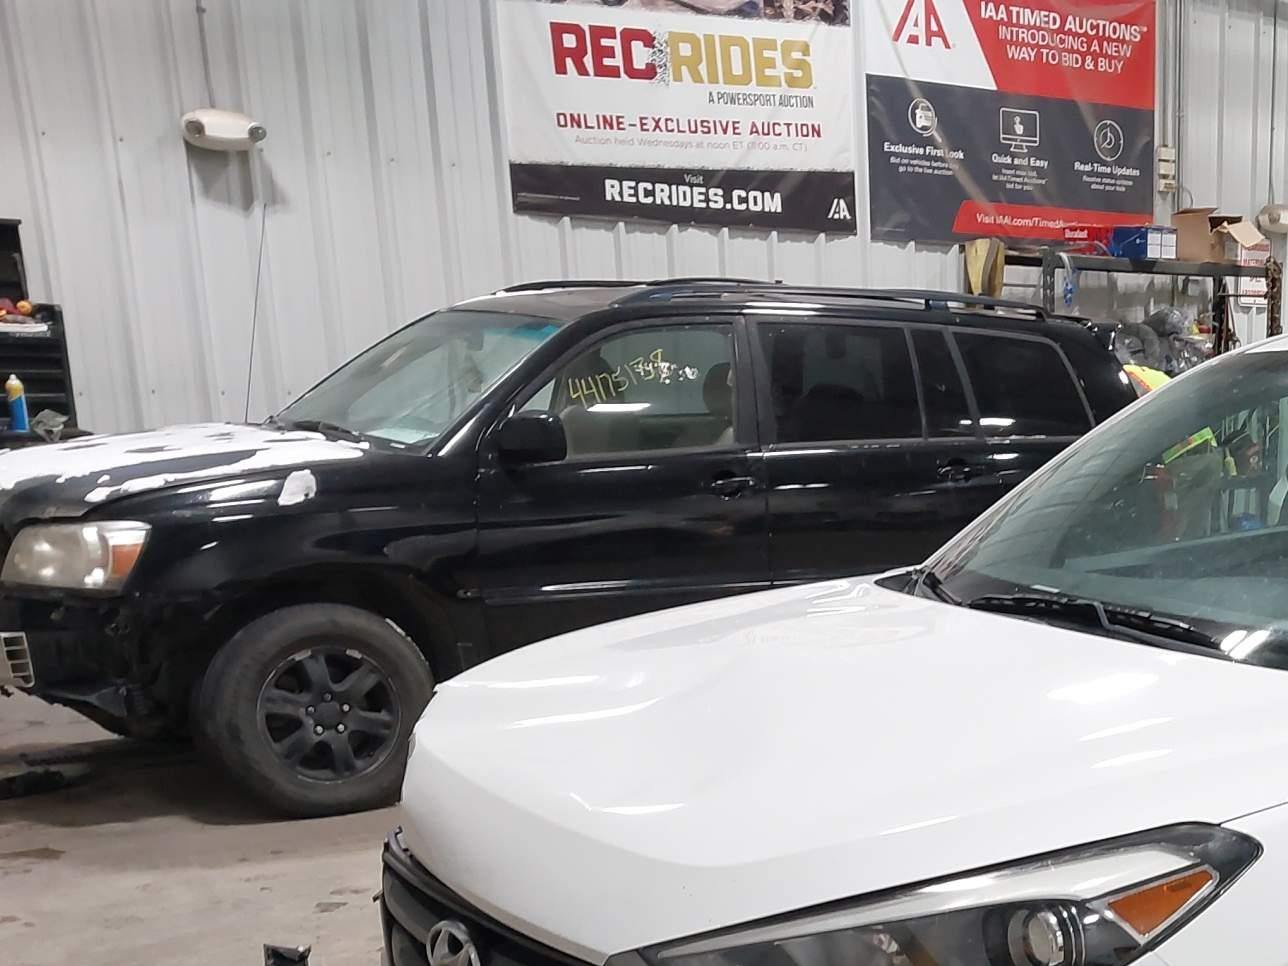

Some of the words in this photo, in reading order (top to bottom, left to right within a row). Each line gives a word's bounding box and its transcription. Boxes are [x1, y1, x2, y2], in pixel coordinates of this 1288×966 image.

[980, 1, 1008, 22] IAA
[1009, 6, 1061, 30] TIMED
[998, 25, 1088, 52] INTRODUCING
[1090, 39, 1100, 53] A
[1102, 41, 1132, 58] NEW
[1006, 45, 1038, 63] WAY
[1040, 49, 1059, 64] TO
[1061, 51, 1082, 68] BID
[1084, 55, 1095, 70] &
[1097, 57, 1124, 74] BUY
[708, 91, 715, 104] A
[717, 91, 776, 107] POWERSPORT
[778, 95, 815, 109] AUCTION
[556, 112, 741, 136] ONLINE-EXCLUSIVE
[749, 121, 822, 138] AUCTION
[575, 135, 612, 145] Auction
[883, 142, 925, 155] Exclusive
[991, 153, 1012, 164] Quick
[1013, 156, 1029, 166] and
[1030, 157, 1049, 170] Easy
[1074, 161, 1112, 174] Real-Time
[1112, 166, 1140, 178] Updates
[683, 173, 704, 184] Visit
[603, 178, 783, 213] RECRIDES.COM
[976, 213, 995, 224] Visit
